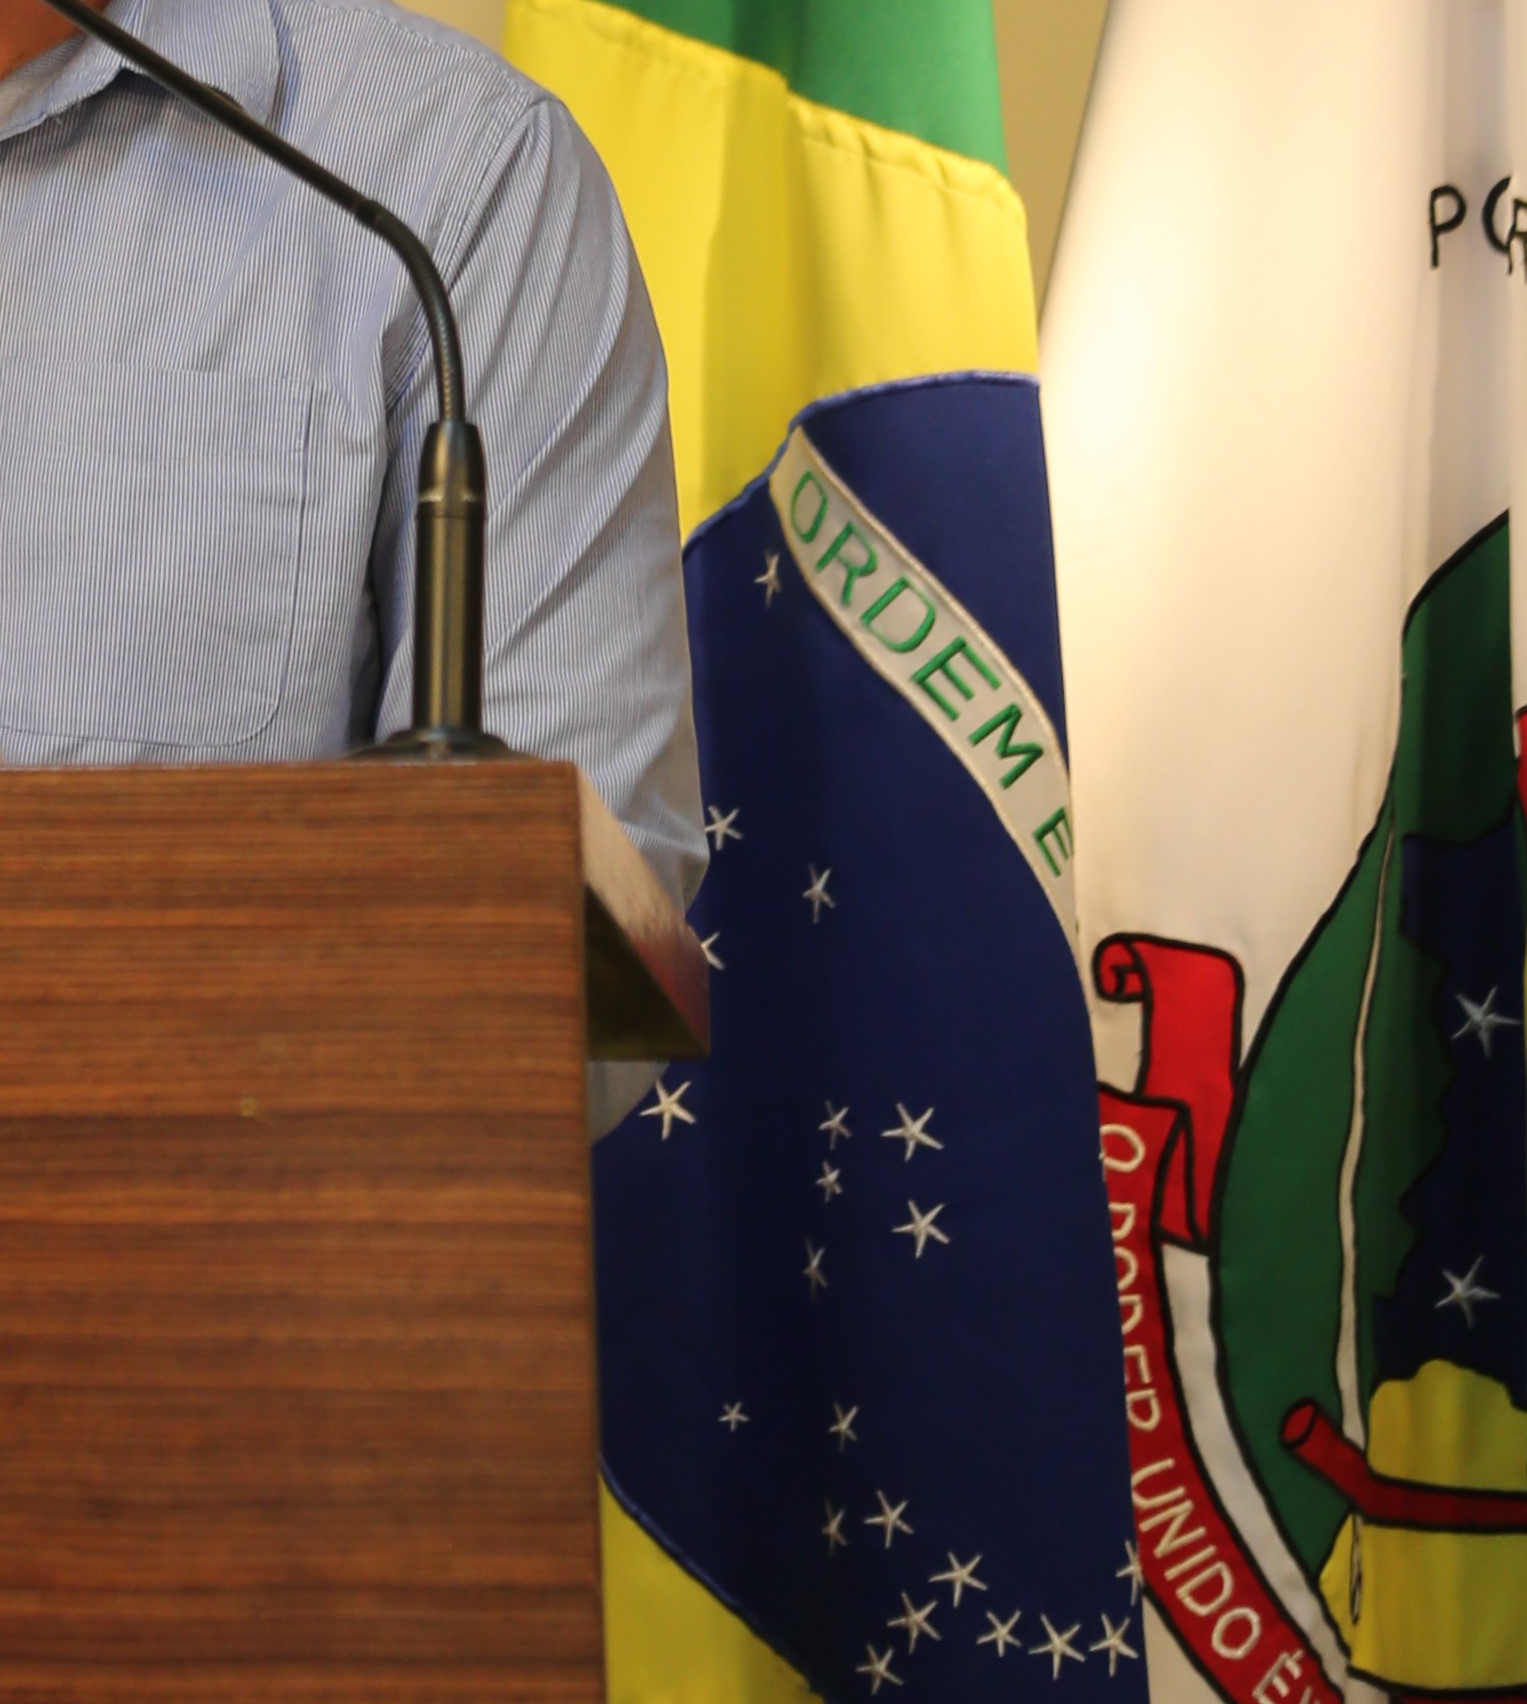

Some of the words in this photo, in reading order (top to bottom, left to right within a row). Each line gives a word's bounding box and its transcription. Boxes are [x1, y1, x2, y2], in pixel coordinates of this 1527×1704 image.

[790, 470, 1044, 789] ORDEM
[1032, 806, 1074, 878] E
[1130, 1457, 1262, 1659] UNIDO
